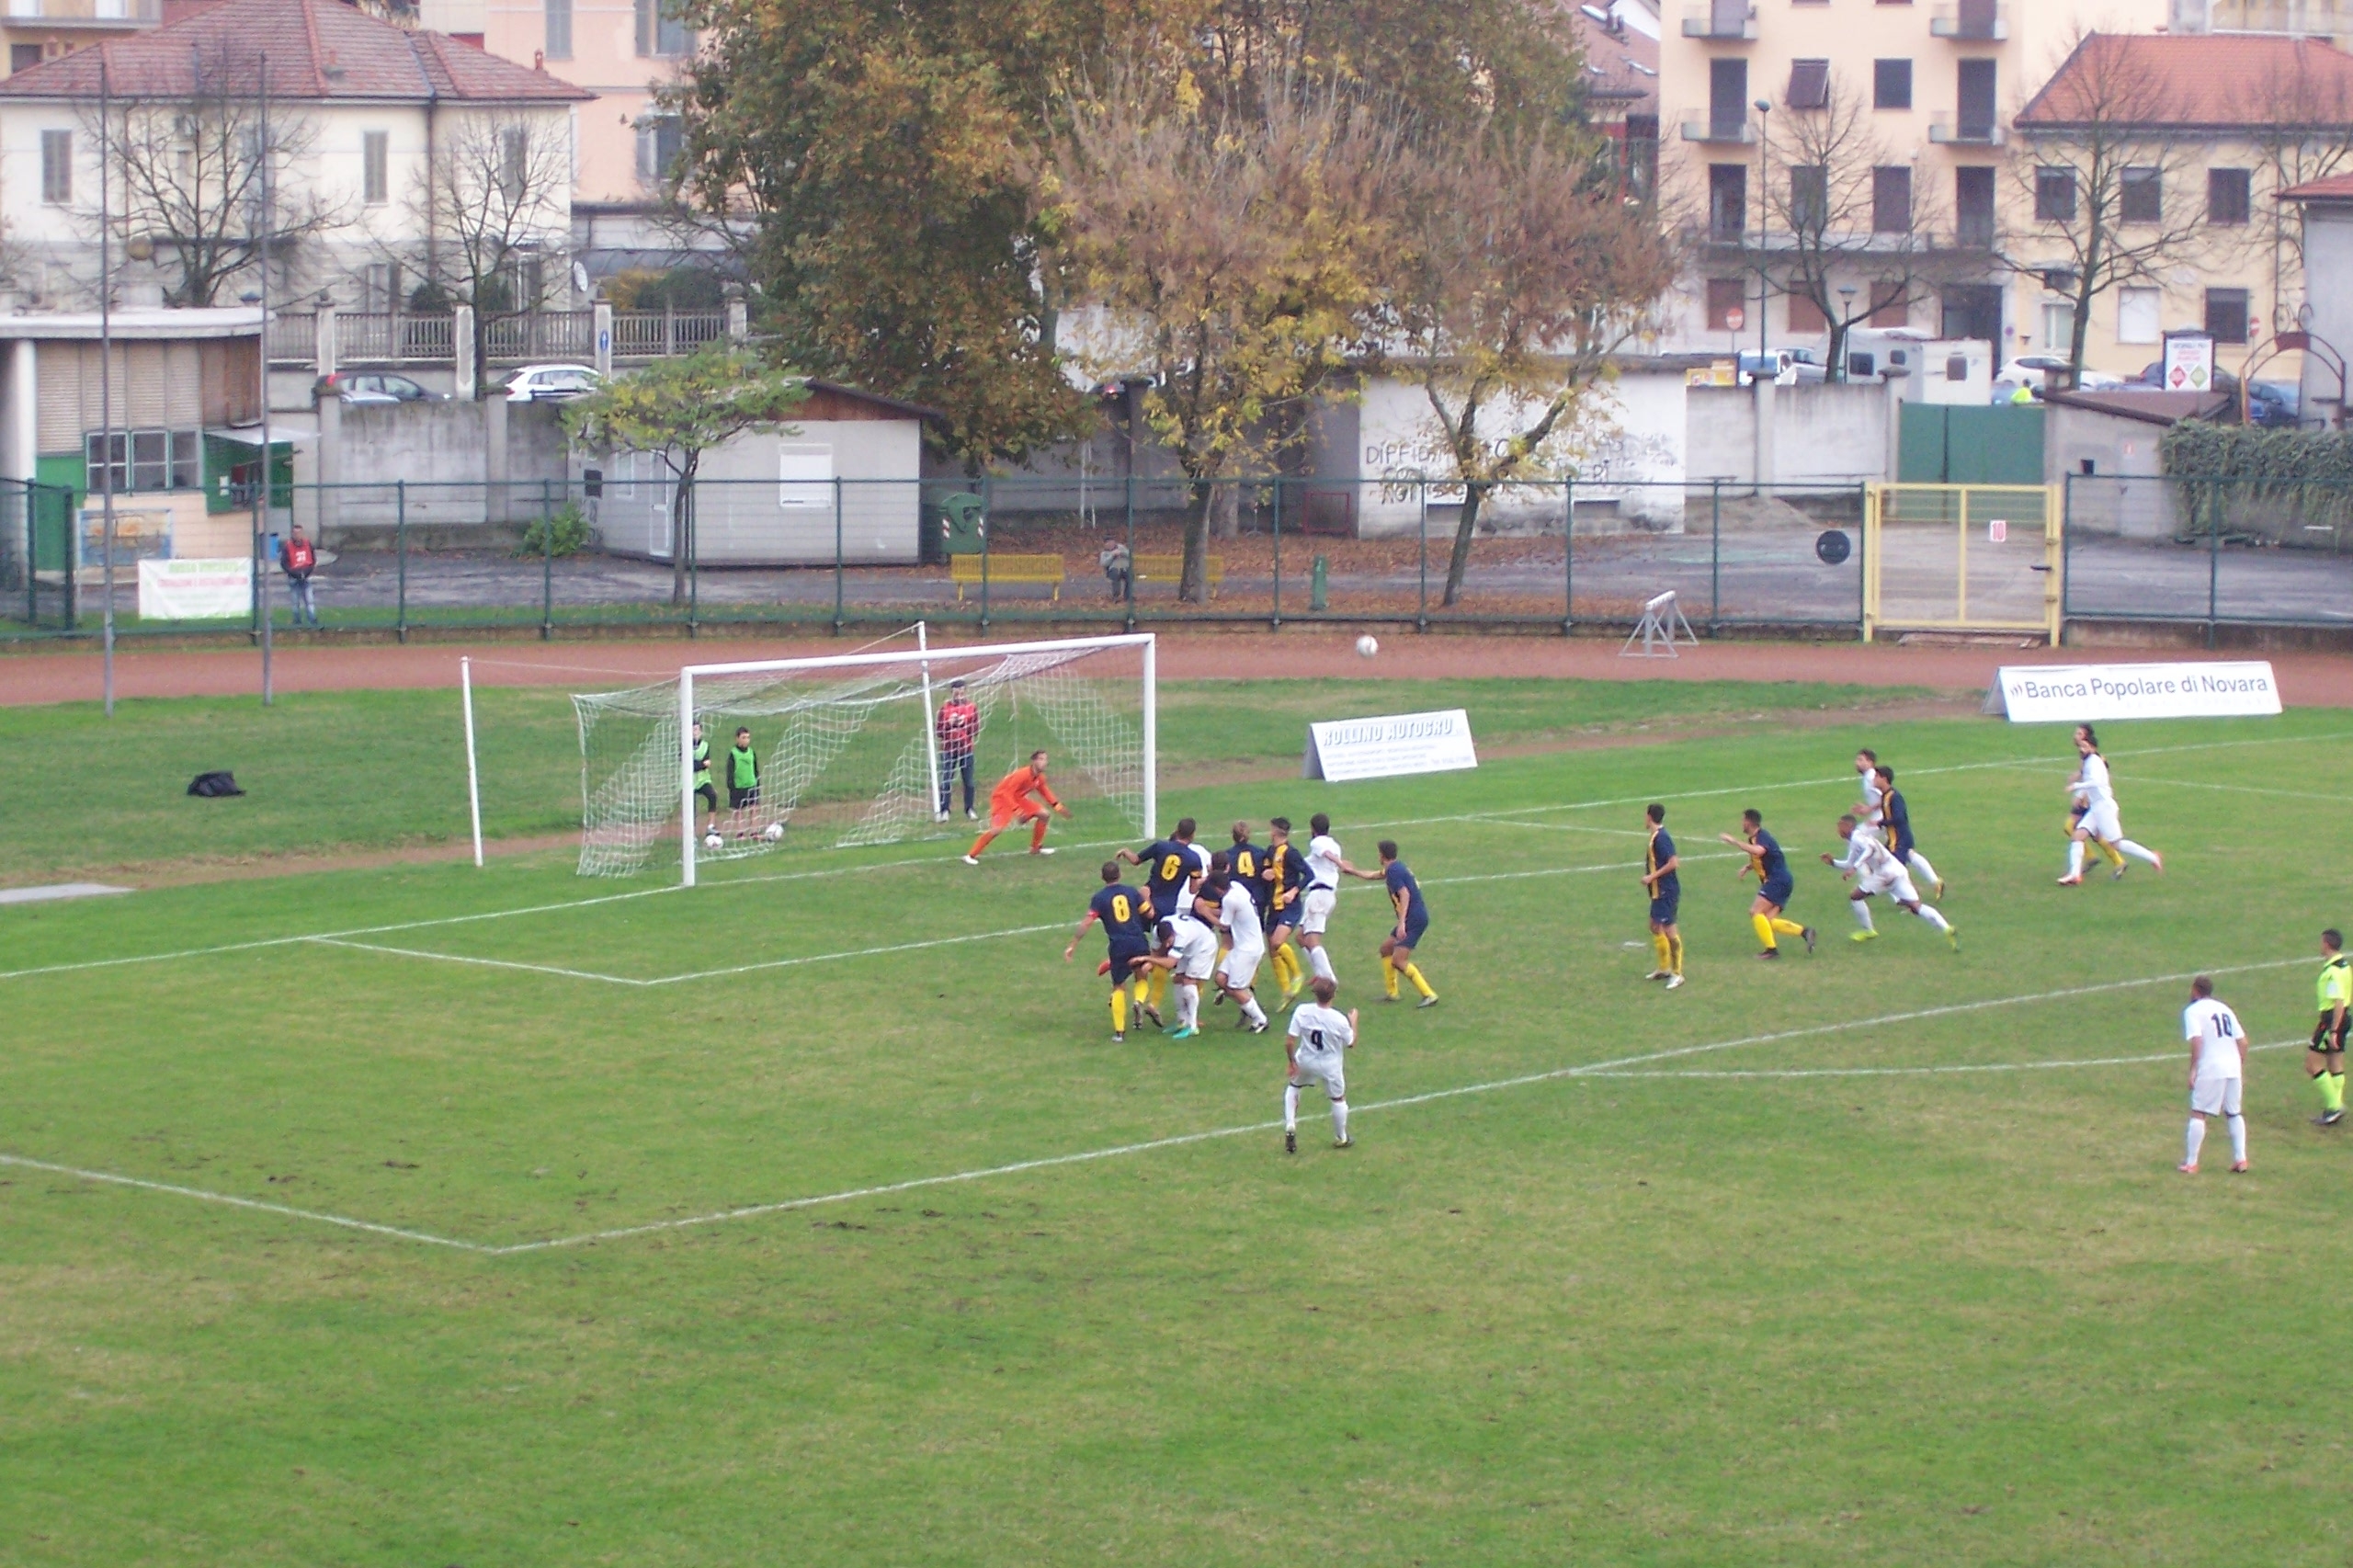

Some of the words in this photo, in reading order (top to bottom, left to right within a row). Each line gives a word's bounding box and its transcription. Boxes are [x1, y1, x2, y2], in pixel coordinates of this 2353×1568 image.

[2025, 680, 2087, 699] Banca
[2089, 677, 2176, 700] Popolare
[2181, 676, 2199, 693] di
[2201, 675, 2268, 693] Novara
[1388, 718, 1453, 740] AUTOGRU
[1160, 854, 1182, 881] 6
[1237, 850, 1256, 878] 4
[1111, 893, 1131, 923] 8
[2211, 1012, 2233, 1038] 10
